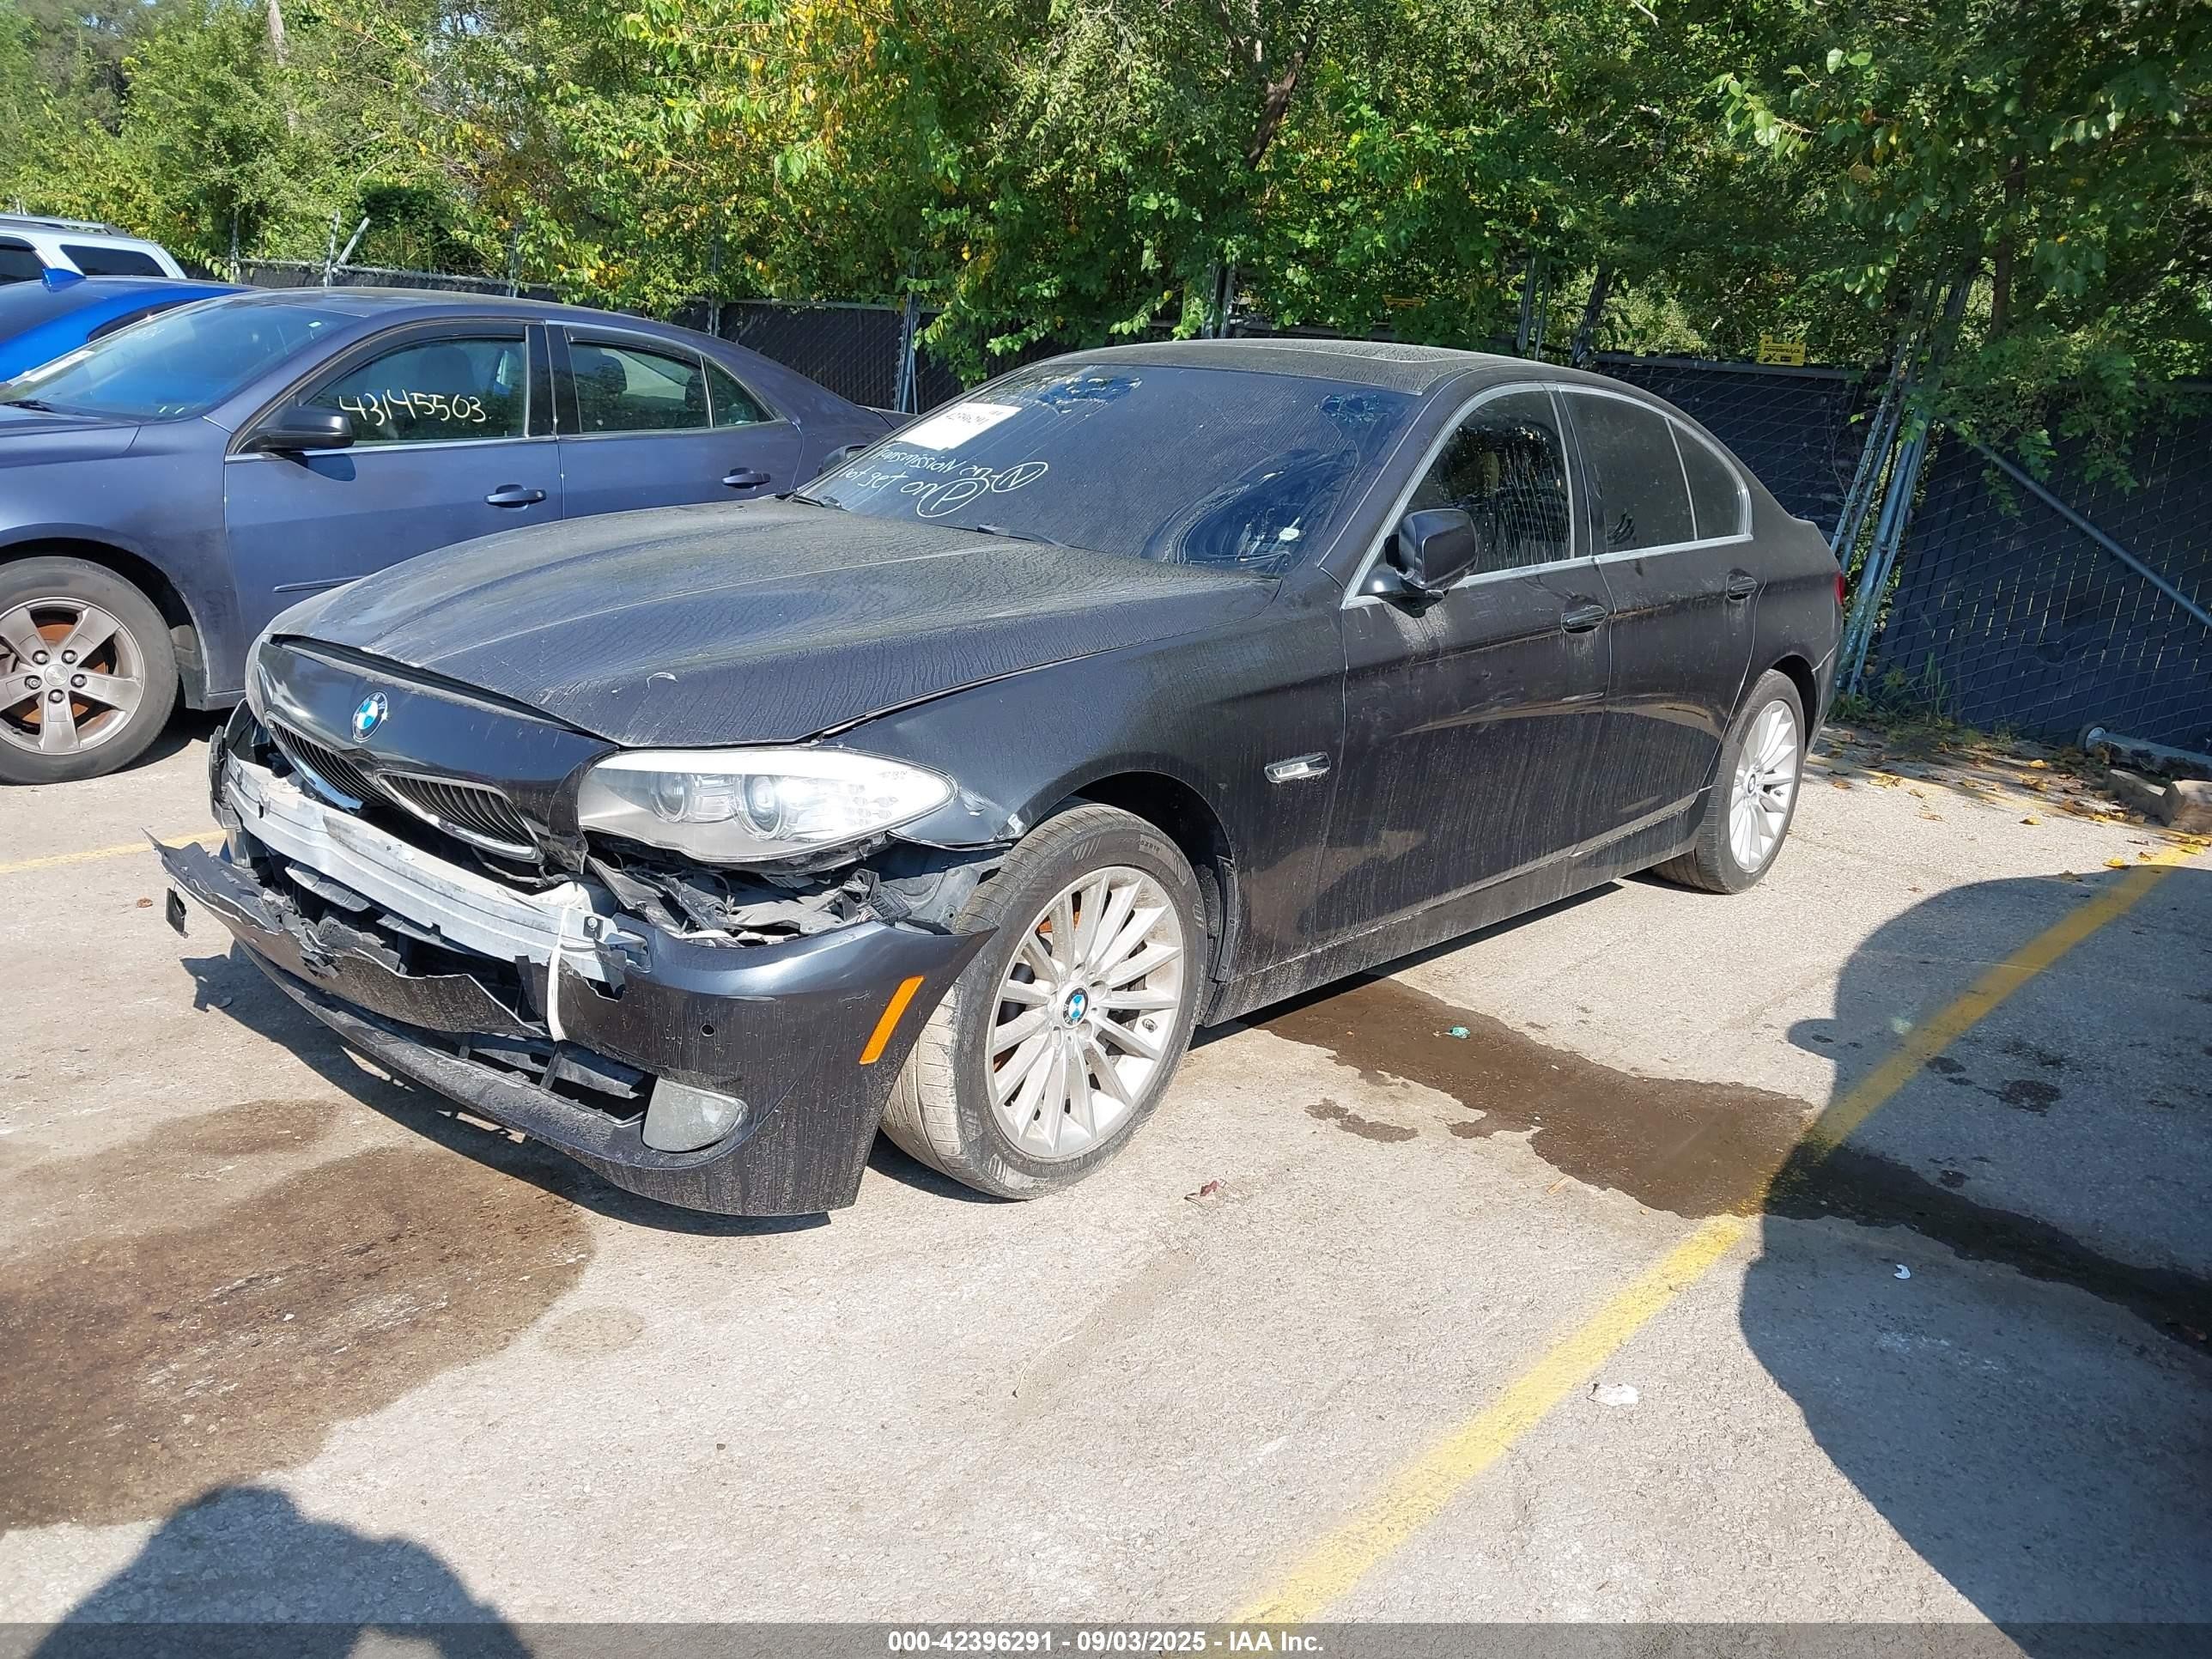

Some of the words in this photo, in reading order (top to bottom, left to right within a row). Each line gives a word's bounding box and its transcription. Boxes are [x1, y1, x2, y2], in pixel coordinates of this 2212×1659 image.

[338, 389, 486, 426] 43145503
[857, 471, 909, 492] get
[901, 481, 939, 496] on
